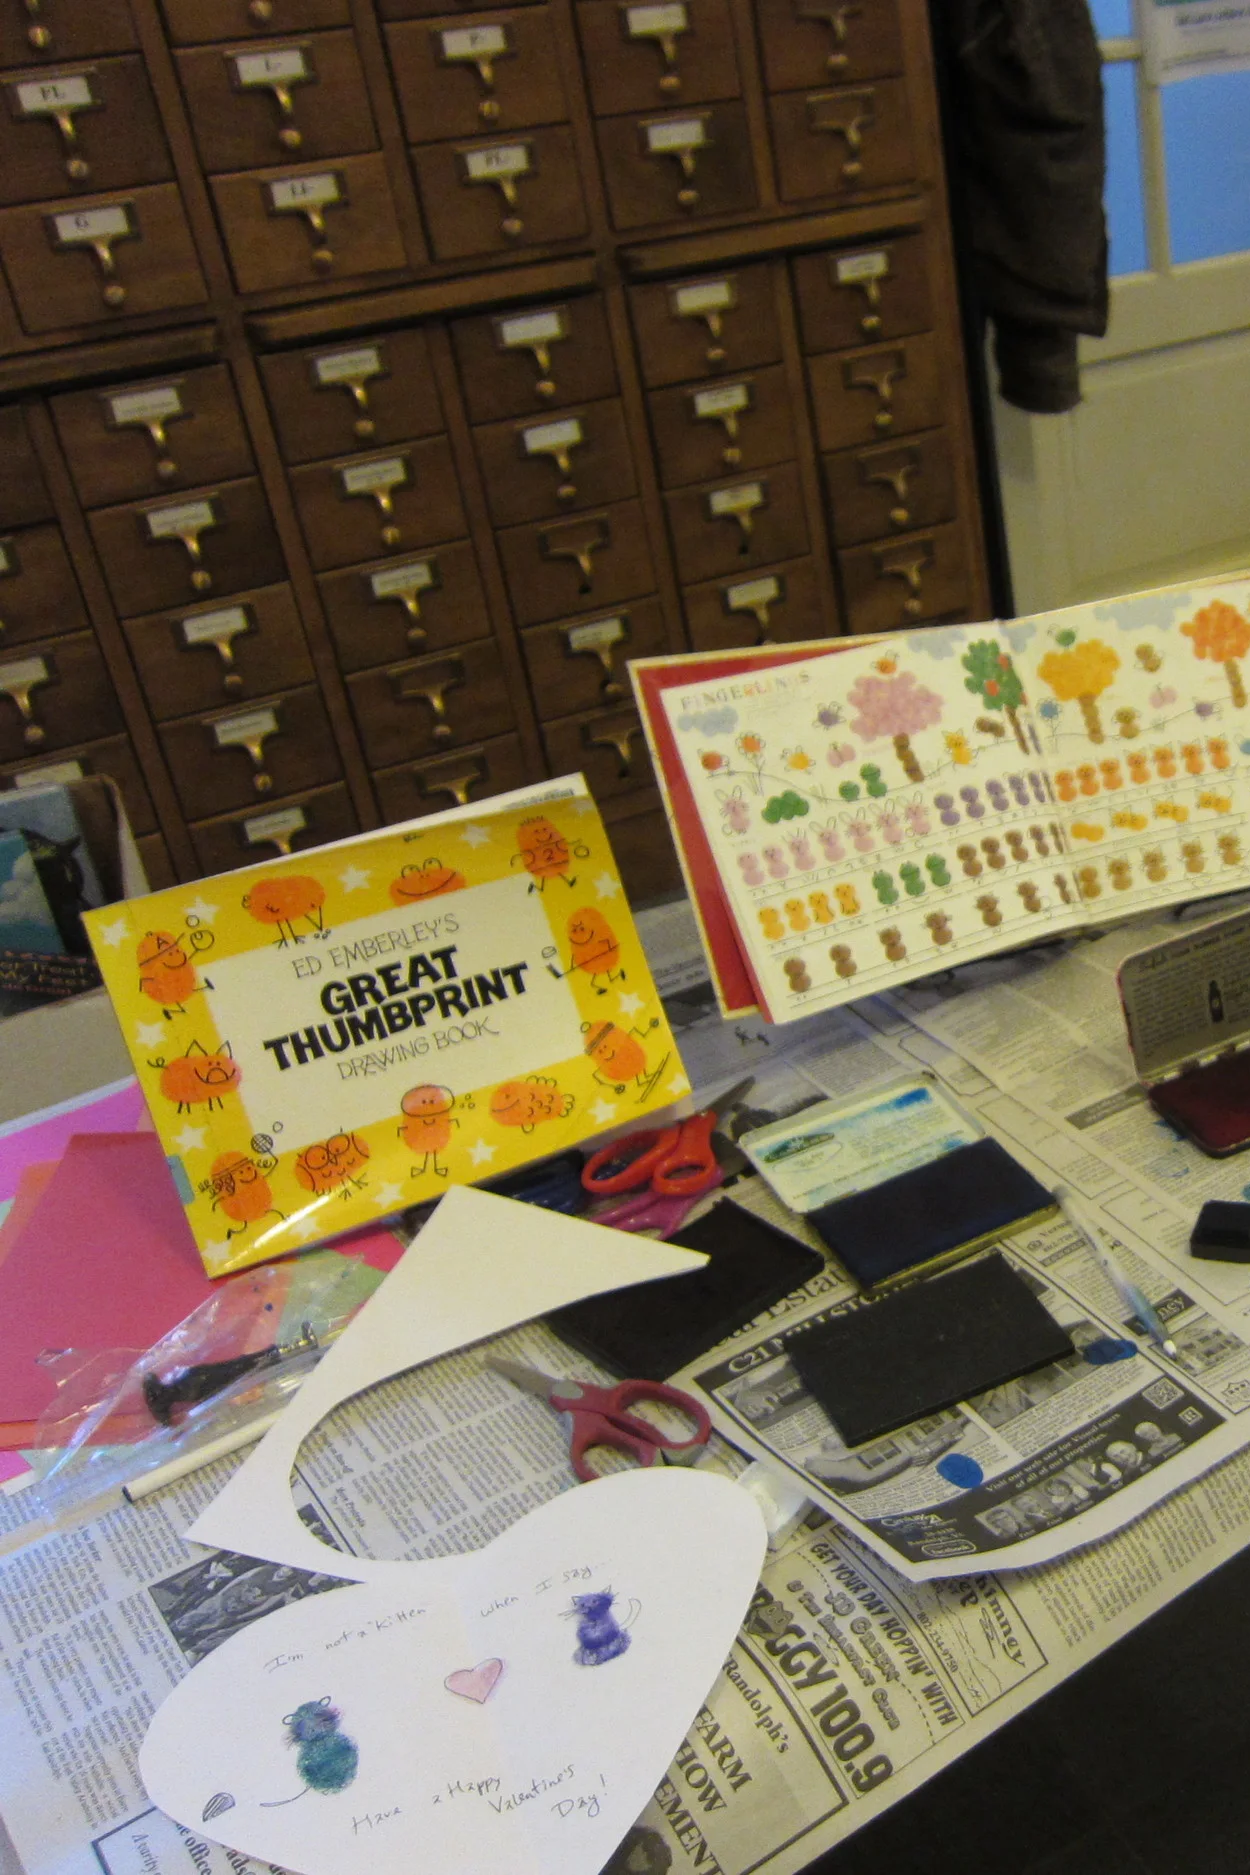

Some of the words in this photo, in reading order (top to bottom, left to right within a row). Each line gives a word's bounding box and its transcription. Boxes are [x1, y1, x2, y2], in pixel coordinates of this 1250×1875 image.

[291, 955, 322, 979] ED
[329, 913, 460, 970] EMBERLEY'S
[320, 944, 460, 1016] GREAT
[263, 960, 529, 1071] THUMBPRINT
[336, 1036, 429, 1080] DRAWING
[432, 1016, 500, 1050] BOOK
[728, 1346, 770, 1374] C21
[1006, 1468, 1025, 1483] our
[1022, 1456, 1043, 1473] web
[325, 1630, 352, 1652] not
[480, 1594, 520, 1619] when
[535, 1579, 552, 1595] I
[809, 1542, 839, 1572] GET
[828, 1560, 869, 1600] YOUR
[859, 1584, 891, 1622] DAY
[879, 1612, 934, 1680] HOPPIN'
[919, 1674, 959, 1727] WITH
[823, 1590, 857, 1618] JD
[809, 1684, 893, 1793] 100.9
[351, 1806, 403, 1835] Have
[447, 1777, 502, 1799] Happy
[488, 1763, 575, 1814] Valentine's
[550, 1772, 607, 1818] Day!
[184, 1835, 214, 1875] office
